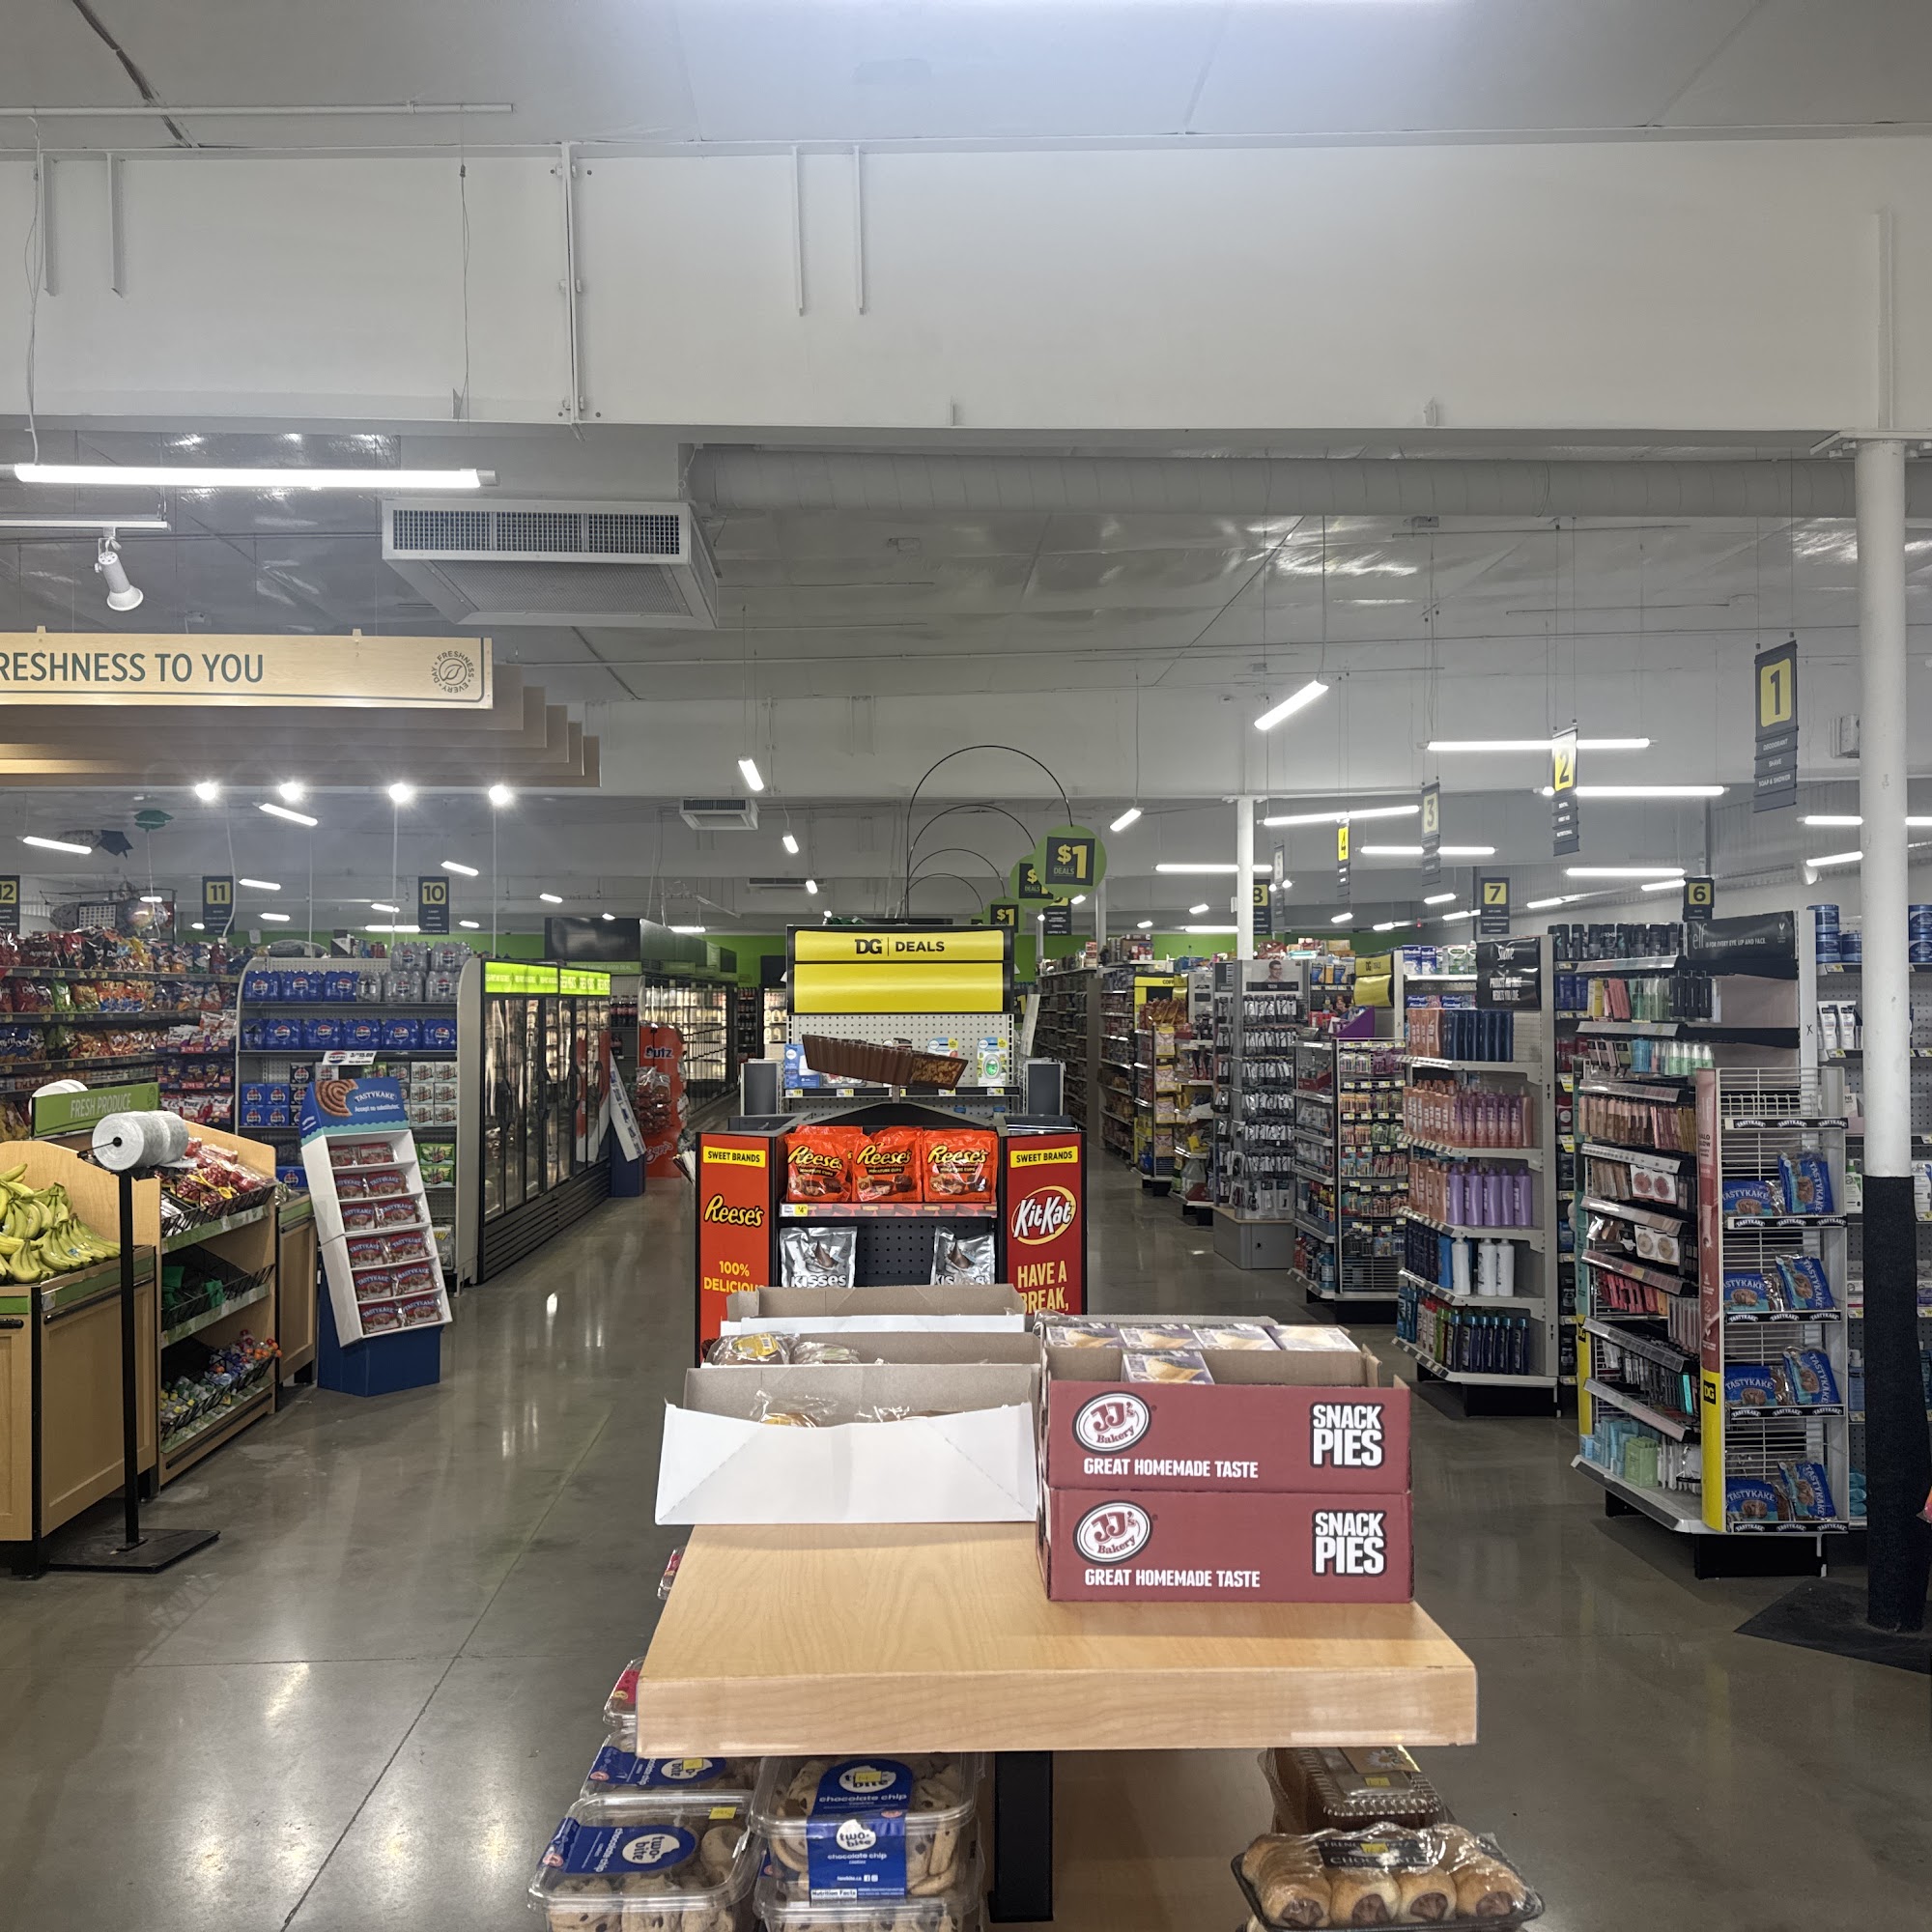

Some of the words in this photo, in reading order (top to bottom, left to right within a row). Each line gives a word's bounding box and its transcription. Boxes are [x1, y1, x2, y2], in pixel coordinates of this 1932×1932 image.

[155, 653, 192, 682] TO
[202, 654, 264, 683] YOU
[437, 650, 474, 678] FRESHNESS
[431, 667, 440, 684] DAY
[441, 682, 469, 694] EVERY
[1770, 668, 1780, 716] 1
[1559, 750, 1570, 784] 2
[1426, 798, 1435, 828] 3
[1341, 831, 1346, 856] 4
[1057, 843, 1088, 879] $1
[210, 884, 226, 901] 11
[423, 885, 444, 902] 10
[1489, 886, 1501, 902] 7
[1692, 885, 1707, 902] 6
[996, 908, 1014, 925] $1
[855, 938, 883, 954] DG
[895, 941, 945, 952] DEALS
[1692, 923, 1708, 950] elf
[354, 1091, 395, 1102] TASTYKAKE
[71, 1097, 96, 1119] FRESH
[98, 1094, 131, 1114] PRODUCE
[1777, 1120, 1807, 1128] TASTYKAKE
[707, 1151, 730, 1161] SWEET
[732, 1152, 760, 1163] BRANDS
[856, 1144, 912, 1165] Reese's
[927, 1145, 988, 1164] Reese's
[1016, 1153, 1041, 1164] SWEET
[1043, 1151, 1072, 1161] BRANDS
[1808, 1161, 1824, 1213] TASTYKAKE
[704, 1194, 764, 1227] Reese's
[1013, 1196, 1072, 1237] KitKat
[1736, 1218, 1765, 1227] TASTYKAKE
[1777, 1218, 1806, 1227] TASTYKAKE
[719, 1260, 750, 1277] 100%
[1017, 1263, 1055, 1289] HAVE
[1058, 1261, 1067, 1283] A
[1724, 1279, 1765, 1291] ASTYKAKE
[1804, 1259, 1823, 1309] TASTYKAKE
[1728, 1314, 1758, 1322] TASTYKAKE
[1725, 1378, 1774, 1391] TASTYKAKE
[1809, 1353, 1831, 1404] TASTYKAKE
[1704, 1386, 1715, 1400] DG
[1312, 1405, 1381, 1430] SNACK
[1096, 1427, 1135, 1445] Bakery
[1313, 1429, 1382, 1466] PIES
[1084, 1458, 1130, 1476] GREAT
[1134, 1459, 1210, 1477] HOMEMADE
[1214, 1461, 1259, 1479] TASTE
[1727, 1490, 1776, 1502] TASTYKAKE
[1805, 1463, 1825, 1517] TASTYKAKE
[1315, 1512, 1383, 1537] SNACK
[1735, 1523, 1765, 1532] TASTYKAKE
[1777, 1523, 1806, 1532] TASTYKAKE
[1097, 1536, 1136, 1555] Bakery
[1315, 1537, 1384, 1574] PIES
[1085, 1569, 1131, 1586] GREAT
[1135, 1569, 1212, 1587] HOMEMADE
[1216, 1571, 1261, 1588] TASTE
[819, 1794, 878, 1803] chocolate
[603, 1828, 623, 1858] chocolate
[633, 1841, 649, 1861] bite
[846, 1838, 871, 1848] bite
[595, 1855, 609, 1872] chip
[868, 1852, 888, 1861] chip
